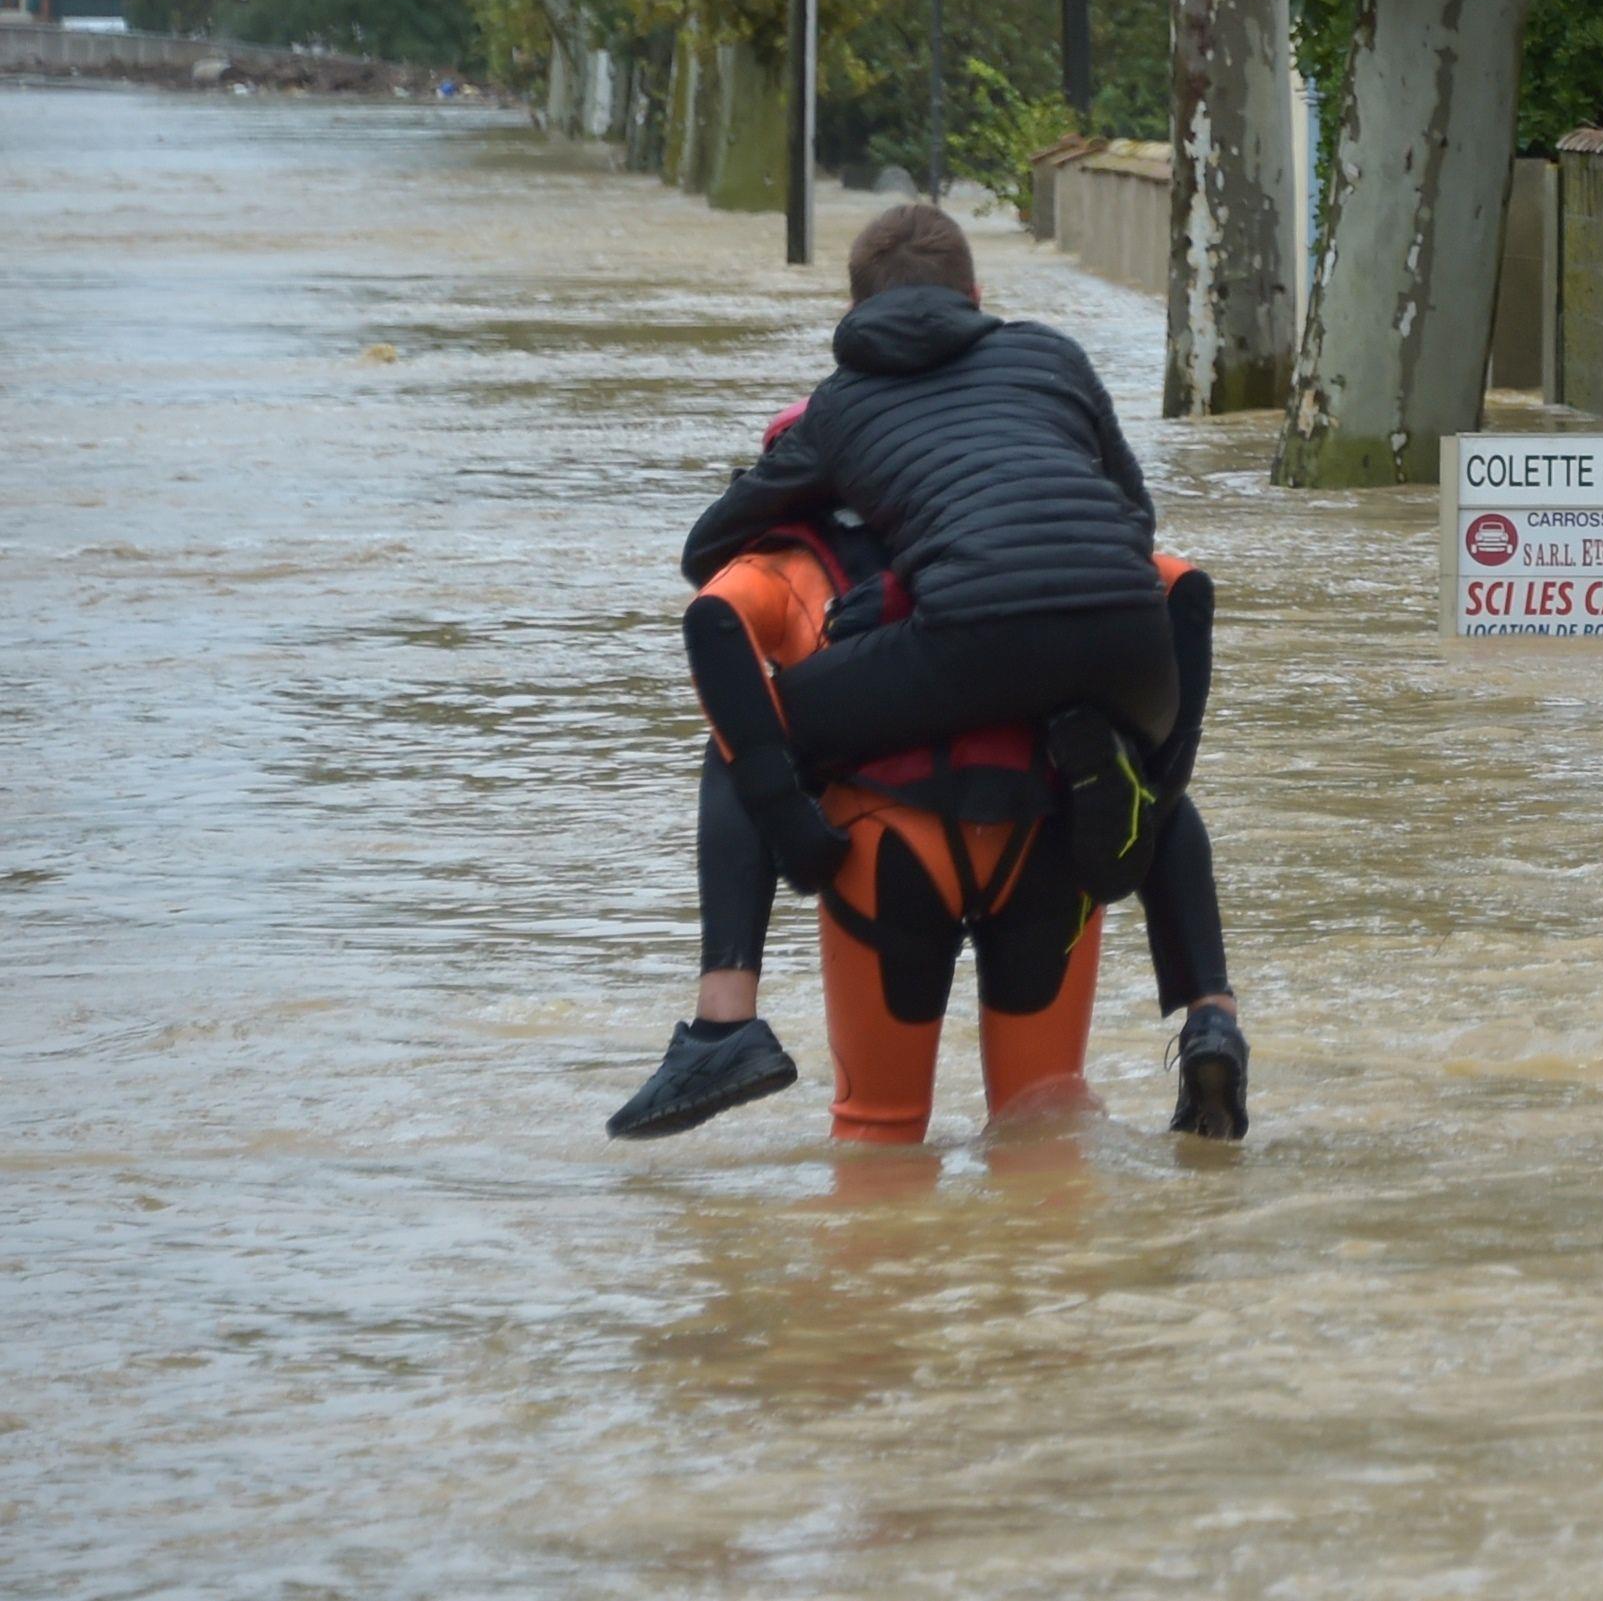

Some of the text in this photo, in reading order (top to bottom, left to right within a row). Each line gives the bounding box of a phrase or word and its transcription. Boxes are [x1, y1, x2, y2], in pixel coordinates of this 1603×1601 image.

[1466, 454, 1595, 488] COLETTE
[1465, 581, 1515, 616] SCI
[1524, 581, 1574, 616] LES
